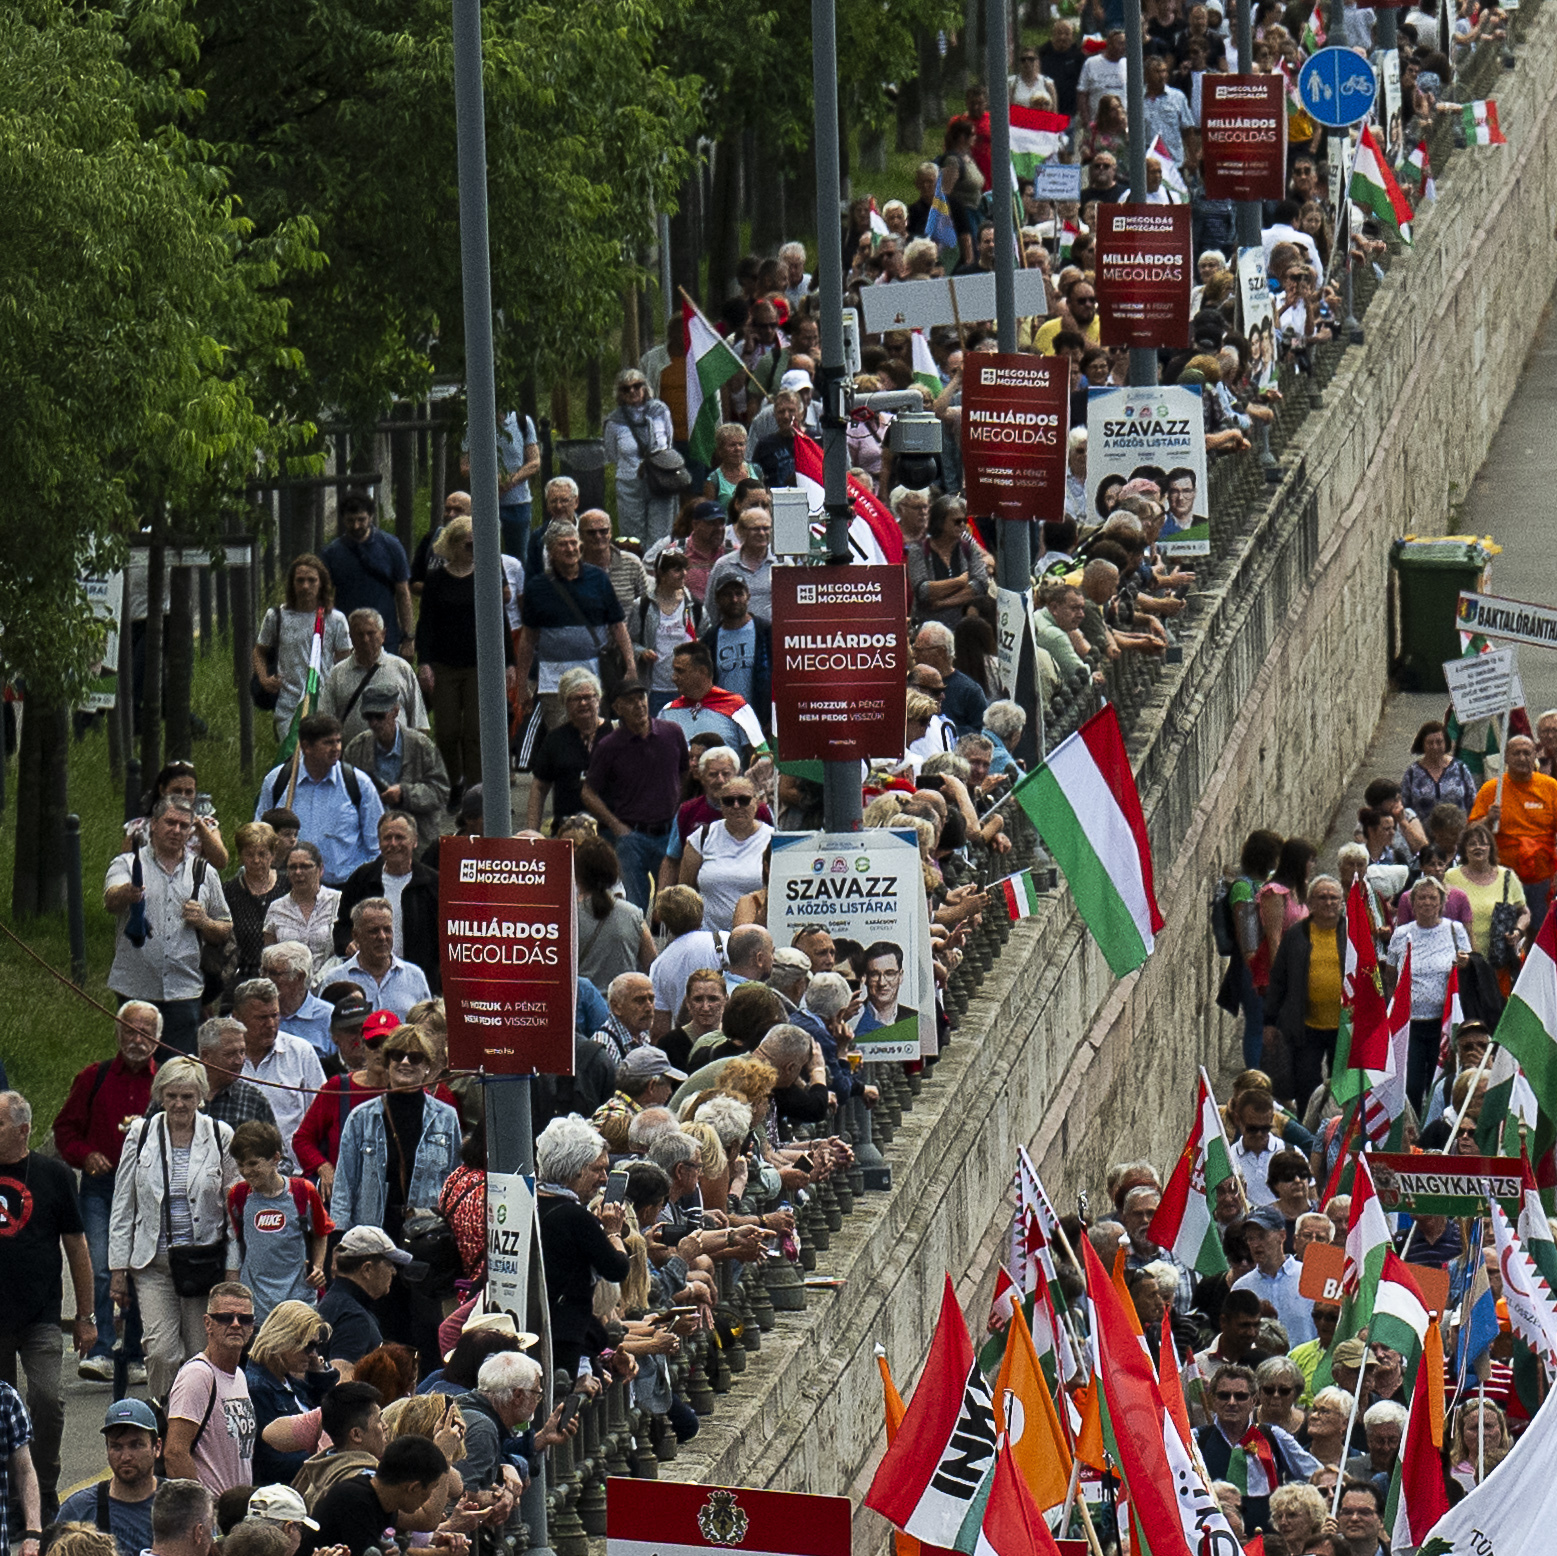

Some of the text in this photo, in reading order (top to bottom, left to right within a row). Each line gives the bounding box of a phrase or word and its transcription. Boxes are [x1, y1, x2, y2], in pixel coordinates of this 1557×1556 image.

[1207, 117, 1276, 129] MILLIÁRDOS
[1207, 129, 1276, 142] MEGOLDÁS
[1126, 216, 1173, 224] MEGOLDÁS
[1102, 252, 1183, 265] MILLIÁRDOS
[1103, 266, 1182, 281] MEGOLDÁS
[997, 368, 1049, 379] MEGOLDÁS
[996, 378, 1049, 388] MOZGALOM
[969, 410, 1059, 426] MILLIÁRDOS
[969, 426, 1058, 445] MEGOLDÁS
[1103, 420, 1190, 438] SZAVAZZ
[818, 582, 882, 593] MEGOLDÁS
[818, 593, 882, 604] MOZGALOM
[784, 632, 896, 650] MILLIÁRDOS
[785, 649, 896, 671] MEGOLDÁS
[810, 701, 847, 709] HOZZUK
[850, 700, 856, 708] A
[799, 713, 818, 721] NEM
[821, 713, 847, 721] PEDIG
[477, 859, 546, 873] MEGOLDÁS
[477, 872, 545, 885] MOZGALOM
[785, 877, 898, 901] SZAVAZZ
[785, 899, 898, 915] A KÖZÖS LISTÁRA!
[447, 918, 559, 939] MILLIÁRDOS
[448, 942, 558, 965] MEGOLDÁS
[504, 1002, 512, 1011] A
[258, 1213, 283, 1227] NIKE
